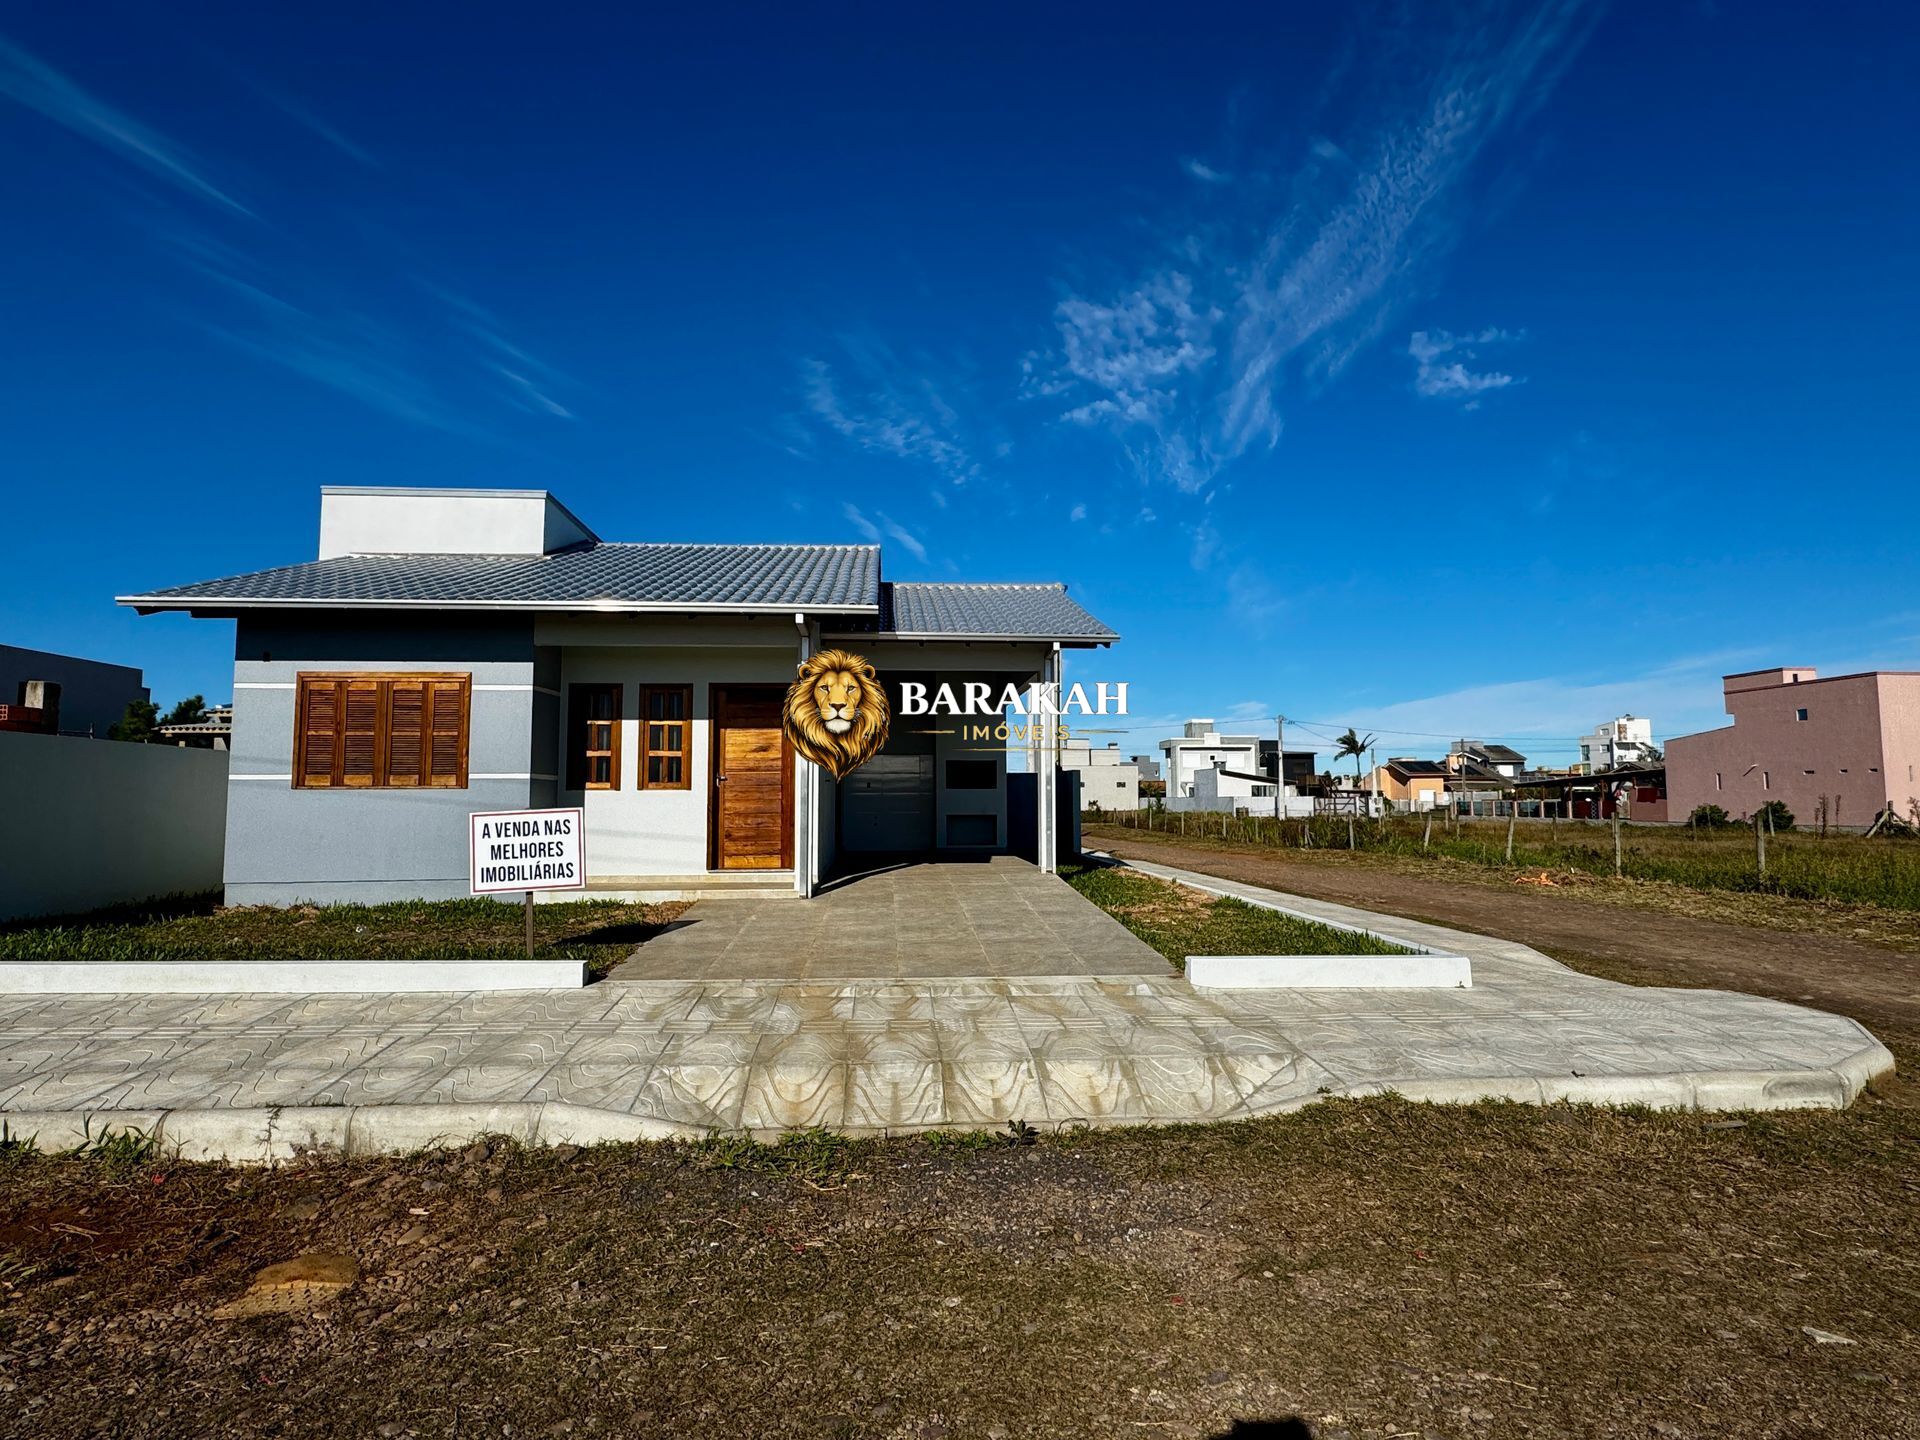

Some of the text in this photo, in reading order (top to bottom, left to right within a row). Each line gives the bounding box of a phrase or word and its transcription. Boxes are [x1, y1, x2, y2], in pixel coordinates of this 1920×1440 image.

[482, 819, 571, 839] A VENDA NAS
[490, 841, 564, 860] MELHORES
[481, 861, 574, 883] IMOBILIÁRIAS
